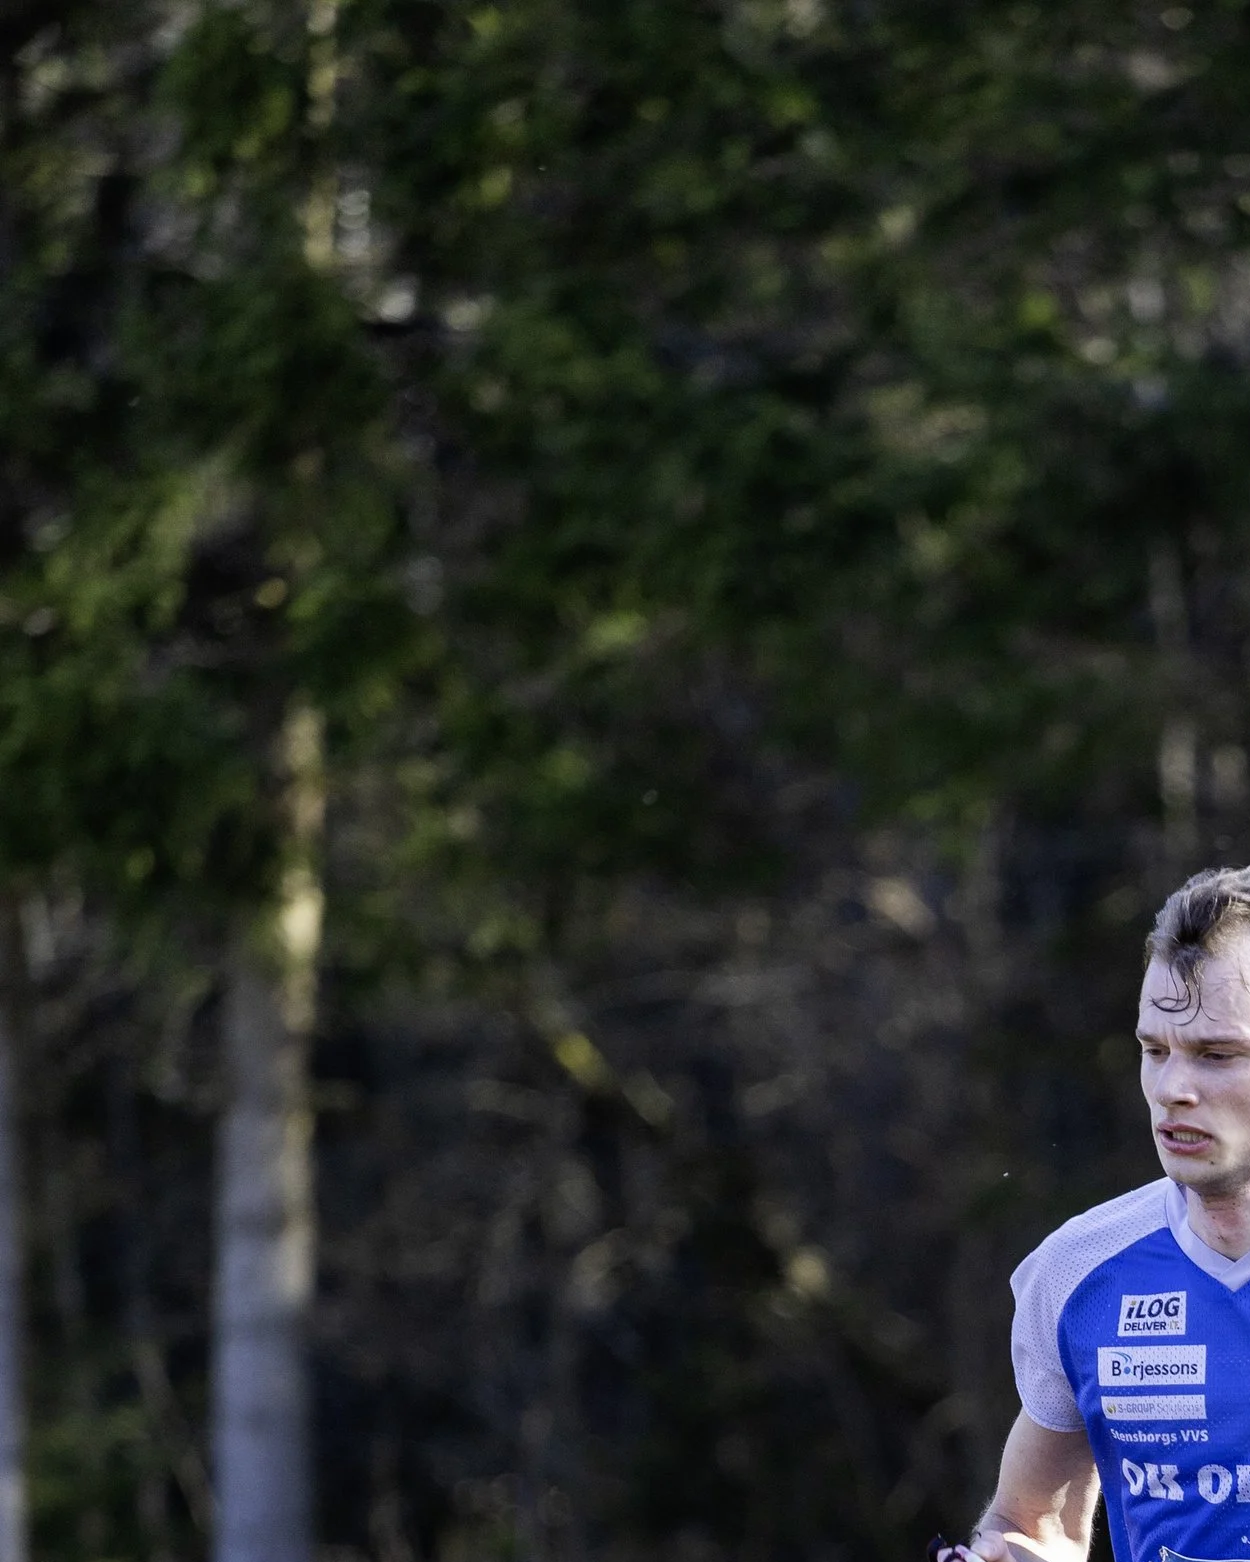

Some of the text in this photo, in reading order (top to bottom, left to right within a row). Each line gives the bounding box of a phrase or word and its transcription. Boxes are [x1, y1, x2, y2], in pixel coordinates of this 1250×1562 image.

[1124, 1321, 1167, 1332] DELIVER
[1118, 1403, 1155, 1414] S-GROUP
[1180, 1429, 1209, 1442] VVS
[1122, 1457, 1185, 1501] OK
